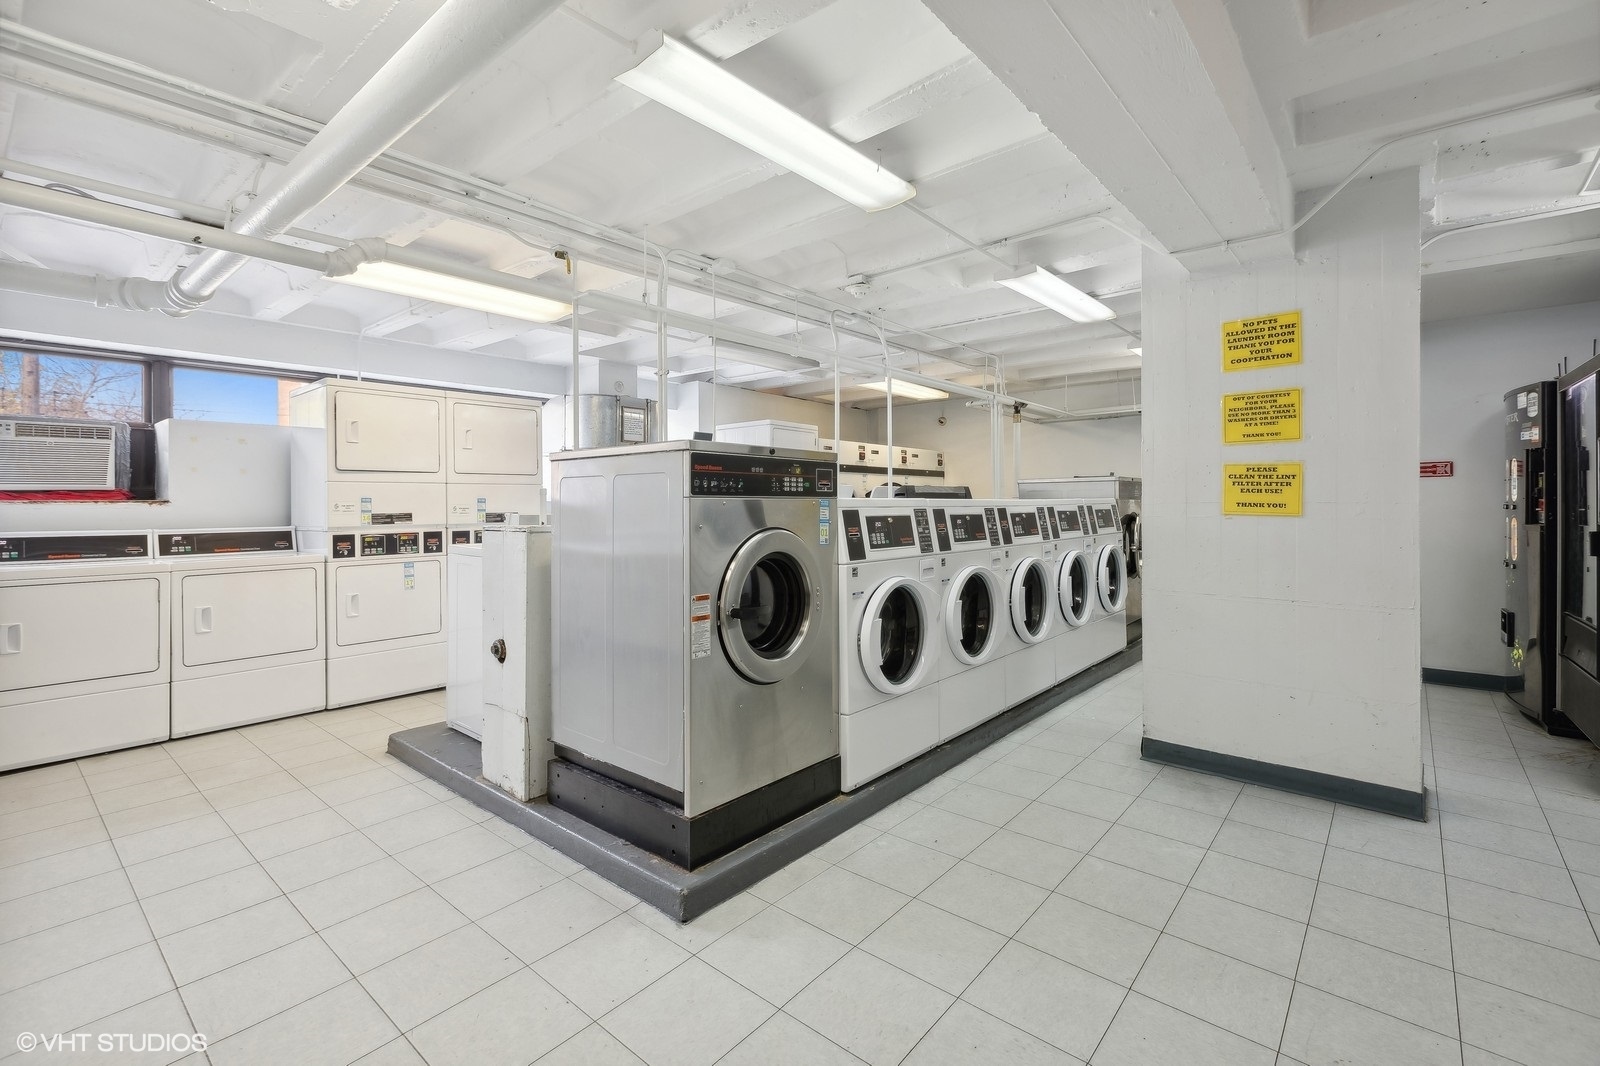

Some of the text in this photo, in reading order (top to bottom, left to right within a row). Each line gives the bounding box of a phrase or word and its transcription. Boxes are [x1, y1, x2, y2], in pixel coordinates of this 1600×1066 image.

[1257, 318, 1278, 326] PETS
[1226, 328, 1265, 337] ALLOWED
[1228, 334, 1266, 344] LAUNDRY
[1231, 353, 1292, 364] COOPERATION
[821, 528, 828, 536] 01
